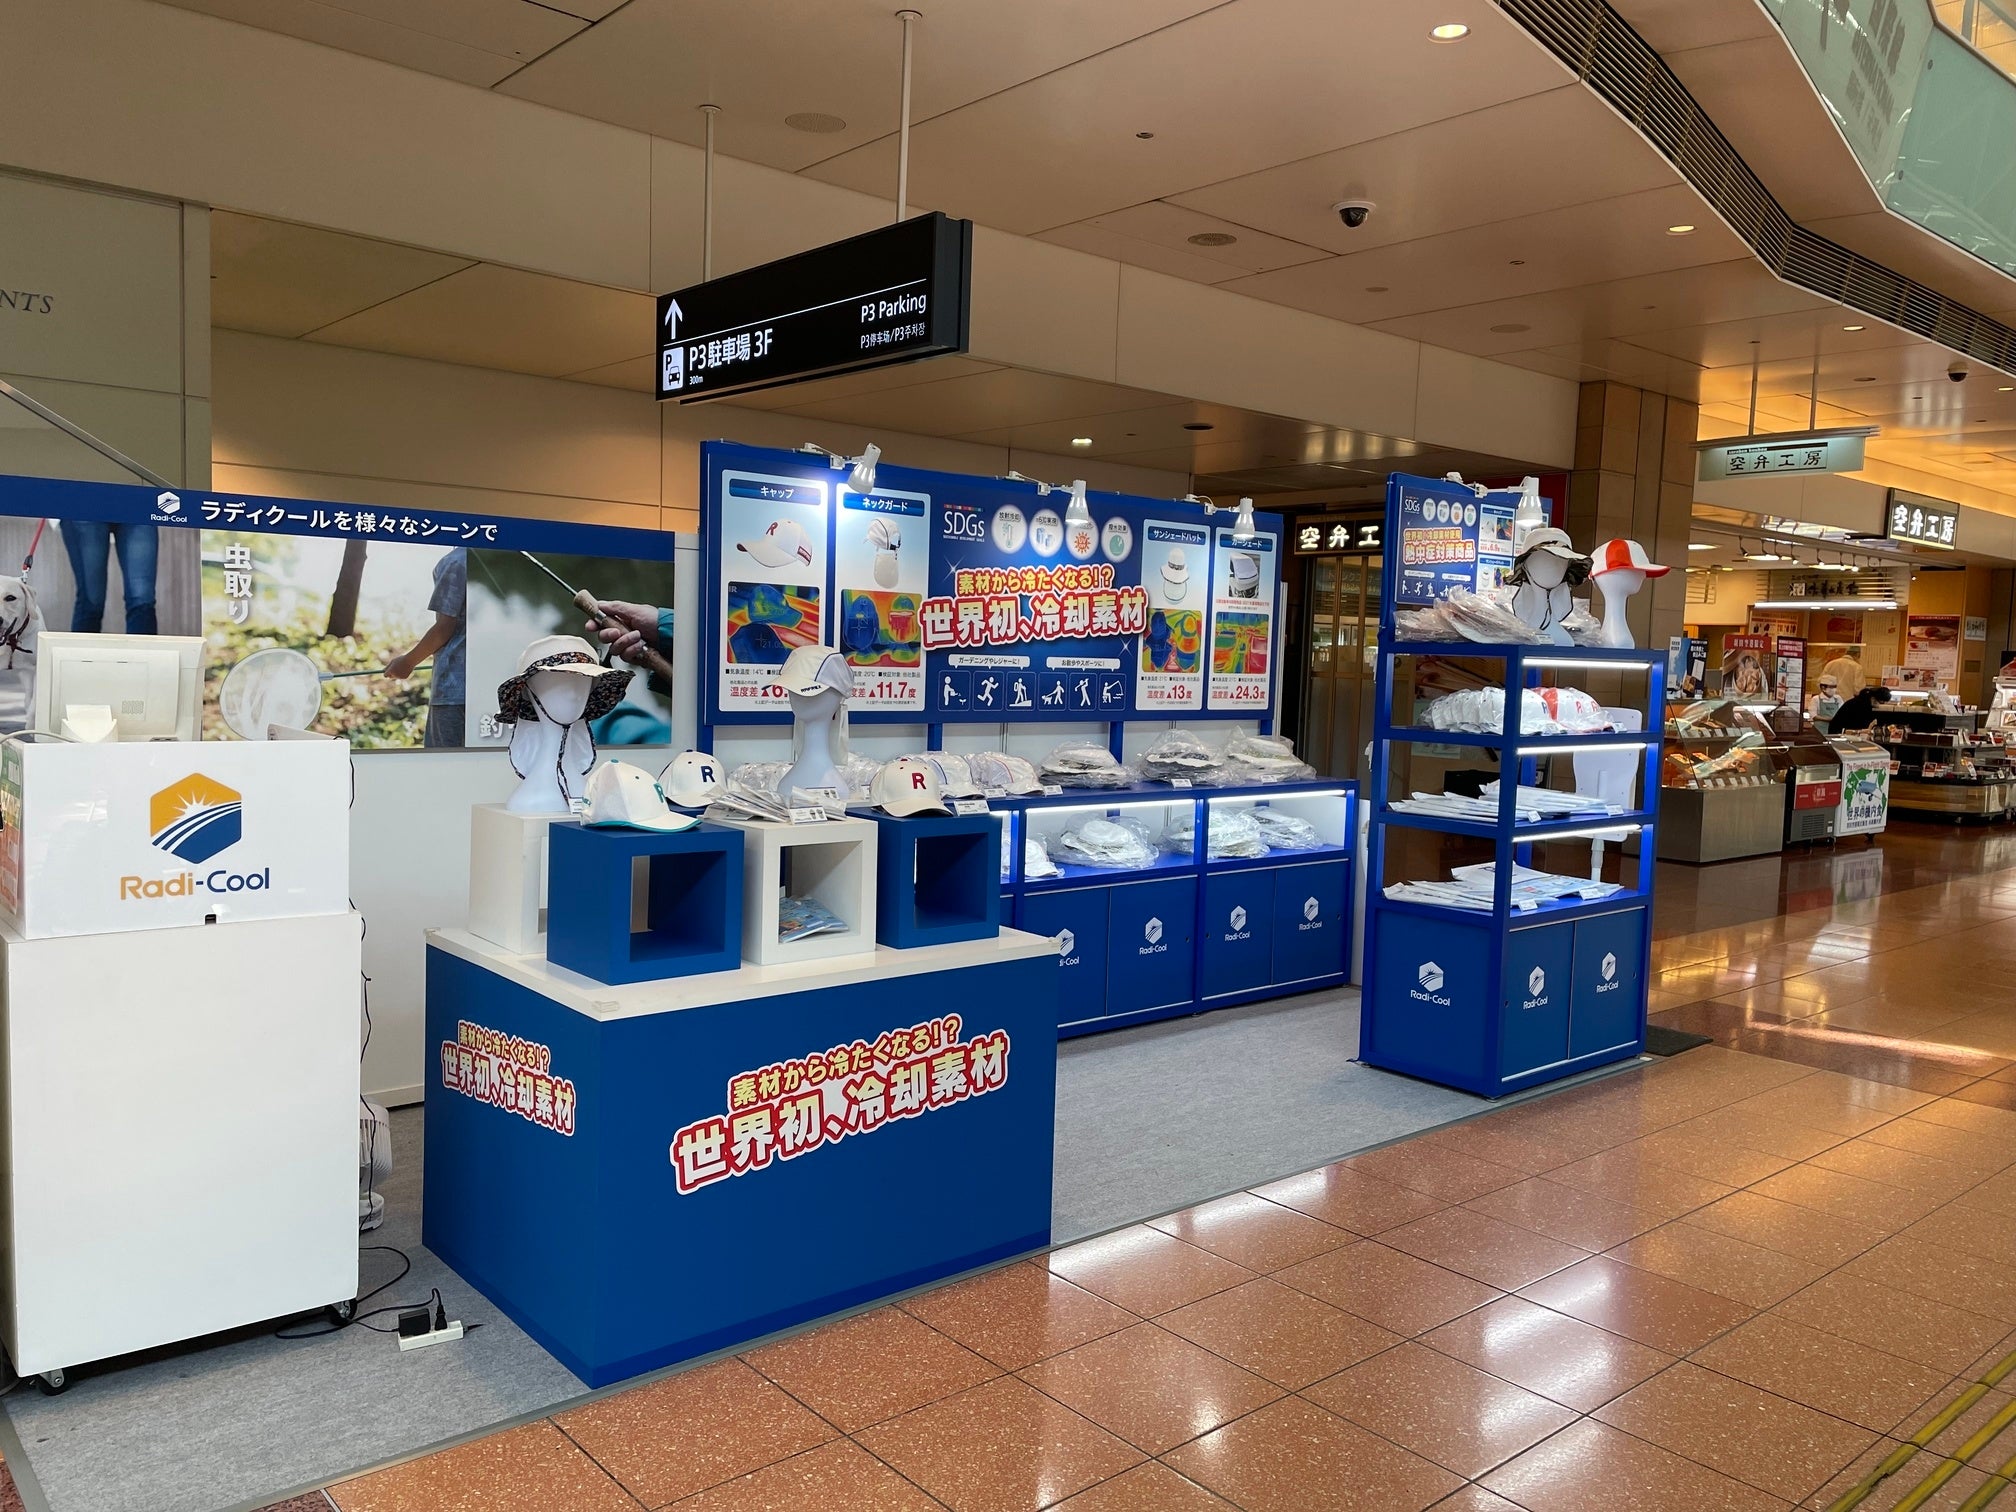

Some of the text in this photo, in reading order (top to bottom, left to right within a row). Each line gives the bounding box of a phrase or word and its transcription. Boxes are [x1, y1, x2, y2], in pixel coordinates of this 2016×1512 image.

[861, 293, 927, 323] P3 Parking
[689, 328, 773, 371] P3駐車場 3F
[689, 375, 704, 386] 300m
[1729, 450, 1823, 471] 空弁工房
[760, 485, 795, 499] キャップ
[862, 496, 908, 512] ネックガード
[1404, 499, 1420, 512] SDGs
[150, 513, 188, 523] Radi-Cool
[200, 499, 498, 541] ラディクールを様々なシーンで
[943, 510, 985, 537] SDGs
[1893, 504, 1956, 543] 空弁工房
[1153, 529, 1202, 543] サンシェードハット
[1299, 524, 1381, 550] 空弁工
[1404, 541, 1475, 563] 熱中症対策商品
[223, 542, 254, 625] 虫取り
[921, 590, 1147, 646] 世界初、冷却素材
[876, 681, 917, 699] 11.7度
[701, 765, 716, 783] R
[911, 772, 927, 790] R
[120, 867, 270, 900] Radi-Cool
[1298, 920, 1323, 931] Radi-Cool
[1224, 930, 1251, 942] Radi-Cool
[1139, 943, 1168, 956] Radi-Cool
[1596, 980, 1619, 993] Radi-Cool
[1410, 989, 1451, 1007] Radi-Cool
[1523, 996, 1549, 1010] Radi-Cool
[443, 1043, 574, 1133] 世界初、冷却素材
[676, 1034, 1007, 1188] 世界初、冷却素材
